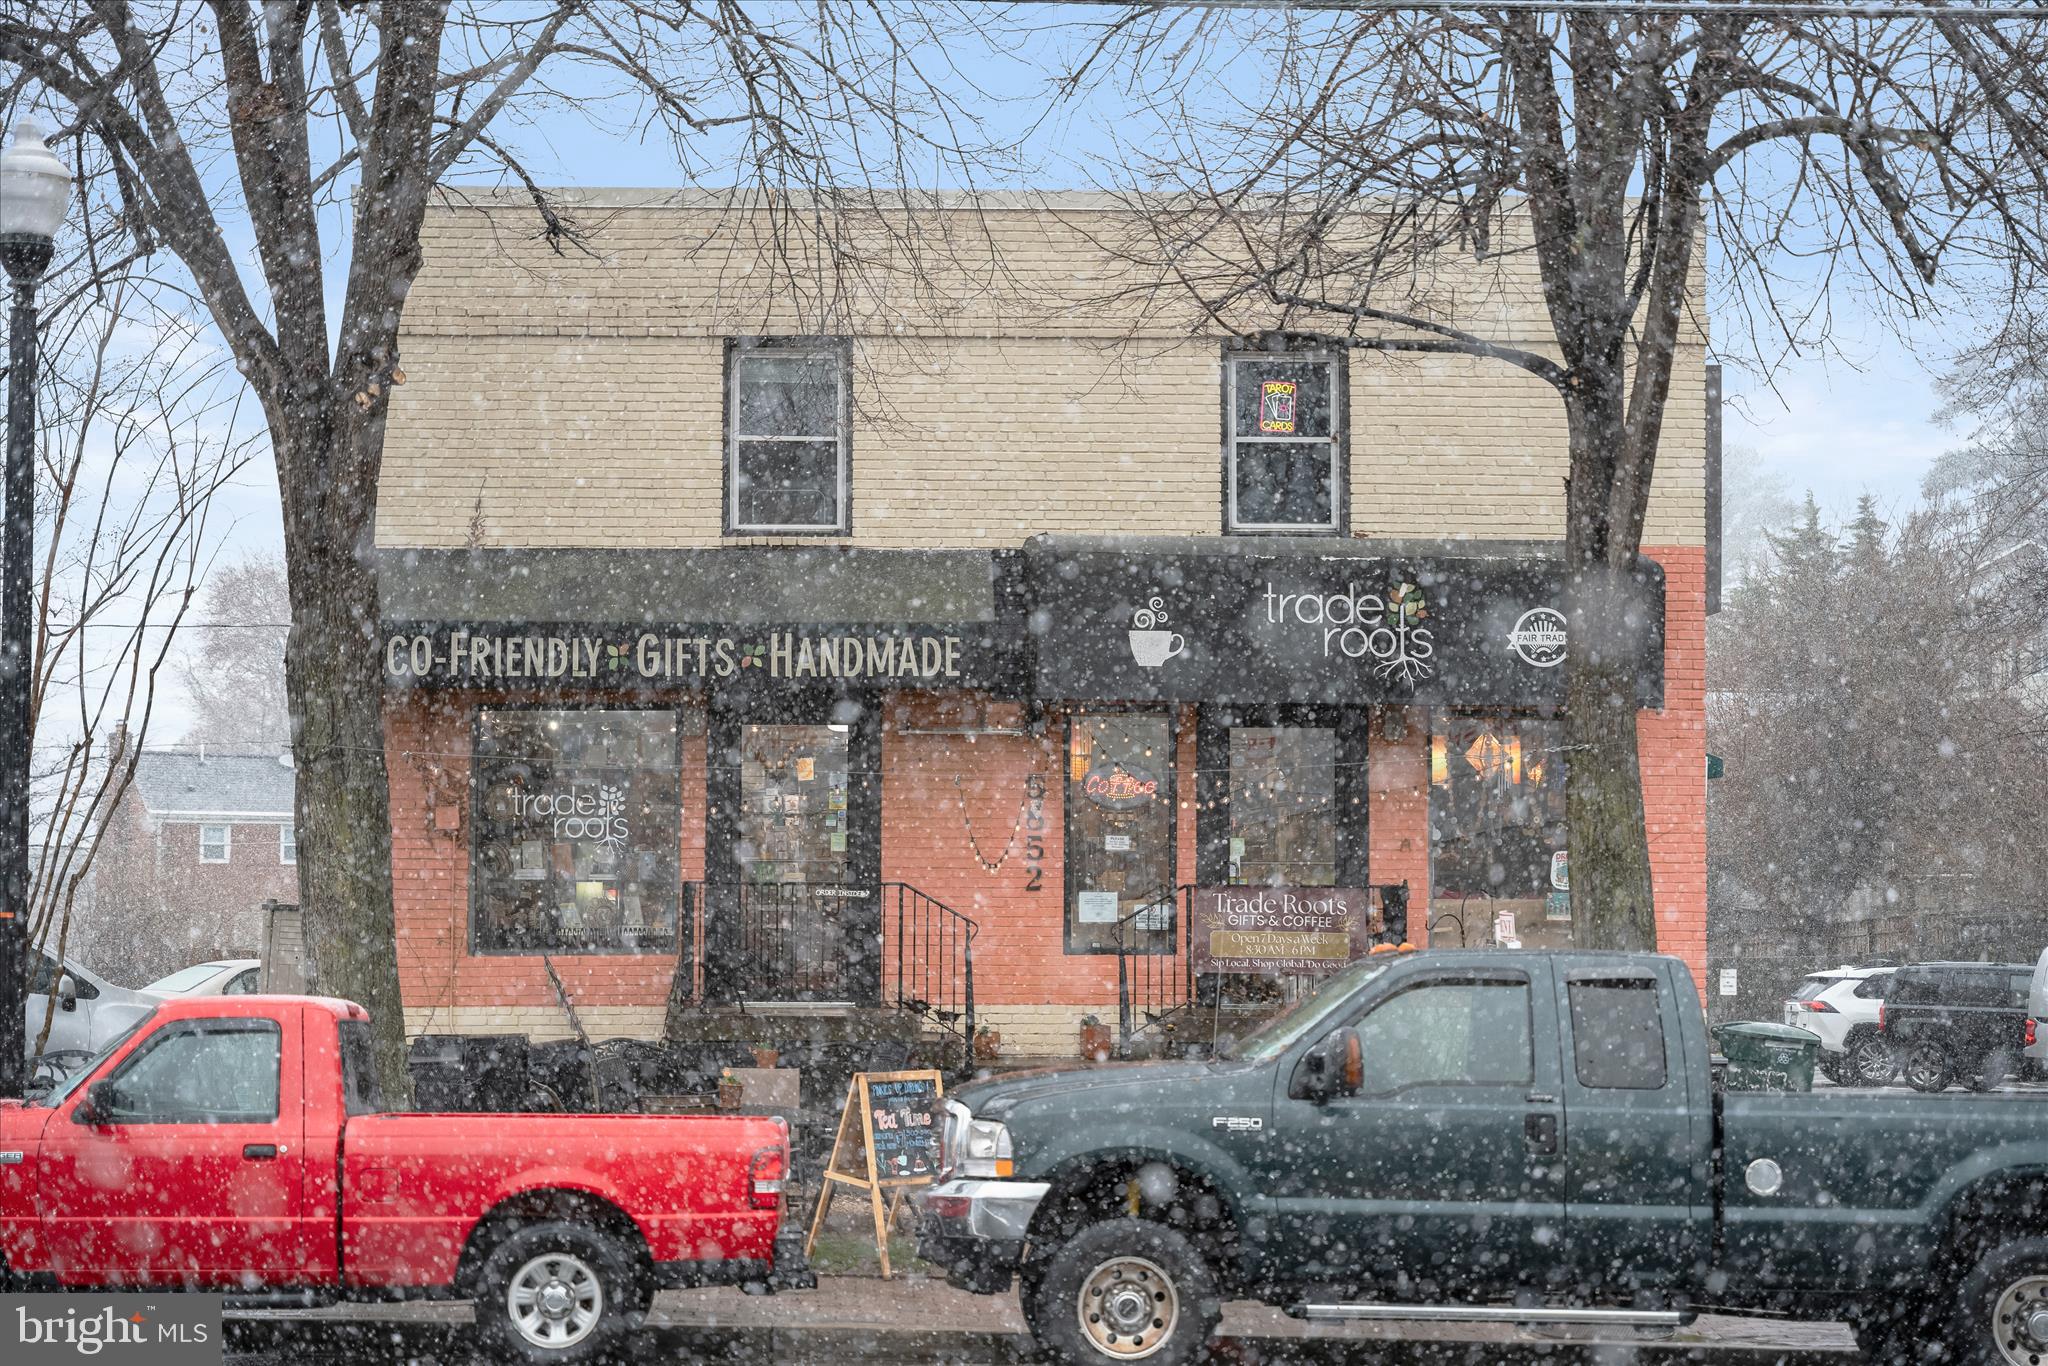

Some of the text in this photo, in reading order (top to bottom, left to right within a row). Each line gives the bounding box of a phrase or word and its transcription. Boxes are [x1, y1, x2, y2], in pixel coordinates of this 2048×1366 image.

[1265, 384, 1295, 394] TAROT
[1262, 420, 1293, 431] CARDS
[1262, 582, 1385, 625] trade
[1324, 604, 1434, 659] roots
[1517, 633, 1566, 643] FAIR TRAD
[386, 631, 961, 678] CO-FRIENDLY GIFTS HANDMADE
[511, 786, 596, 816] trade
[553, 801, 629, 839] roots
[815, 889, 837, 897] ORDER
[1212, 891, 1348, 917] Trade Roots
[1228, 913, 1332, 929] GIFTS & COFFEE
[1231, 933, 1260, 945] Open
[1260, 933, 1267, 944] 7
[1267, 934, 1292, 945] Days
[1300, 935, 1329, 945] Week
[1267, 945, 1285, 955] AM
[1291, 945, 1299, 955] 6
[1300, 945, 1316, 955] PM
[1210, 959, 1224, 969] Sip
[1252, 960, 1275, 969] Shop
[1308, 961, 1321, 969] Do
[874, 1106, 931, 1130] Tea Time
